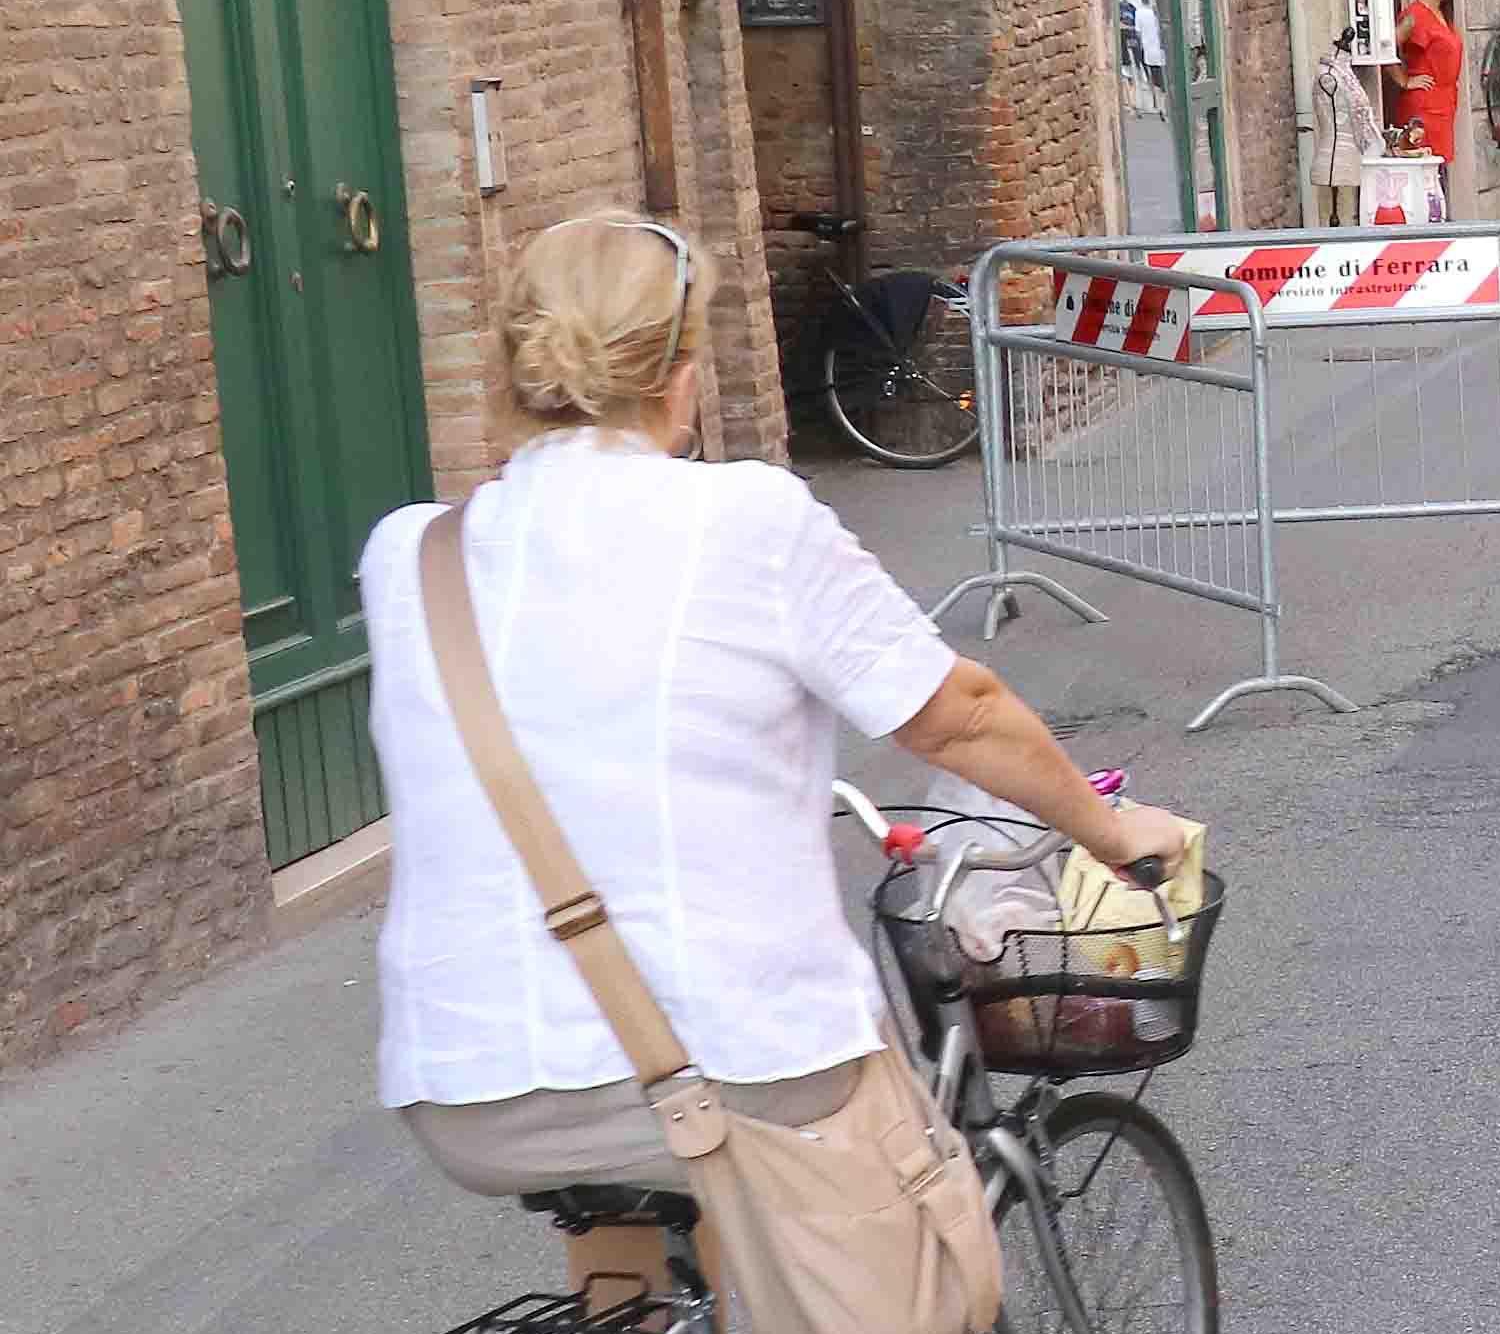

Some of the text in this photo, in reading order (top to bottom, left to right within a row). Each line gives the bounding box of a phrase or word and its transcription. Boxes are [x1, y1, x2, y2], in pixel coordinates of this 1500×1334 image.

[1223, 257, 1471, 282] Comune di Ferrara
